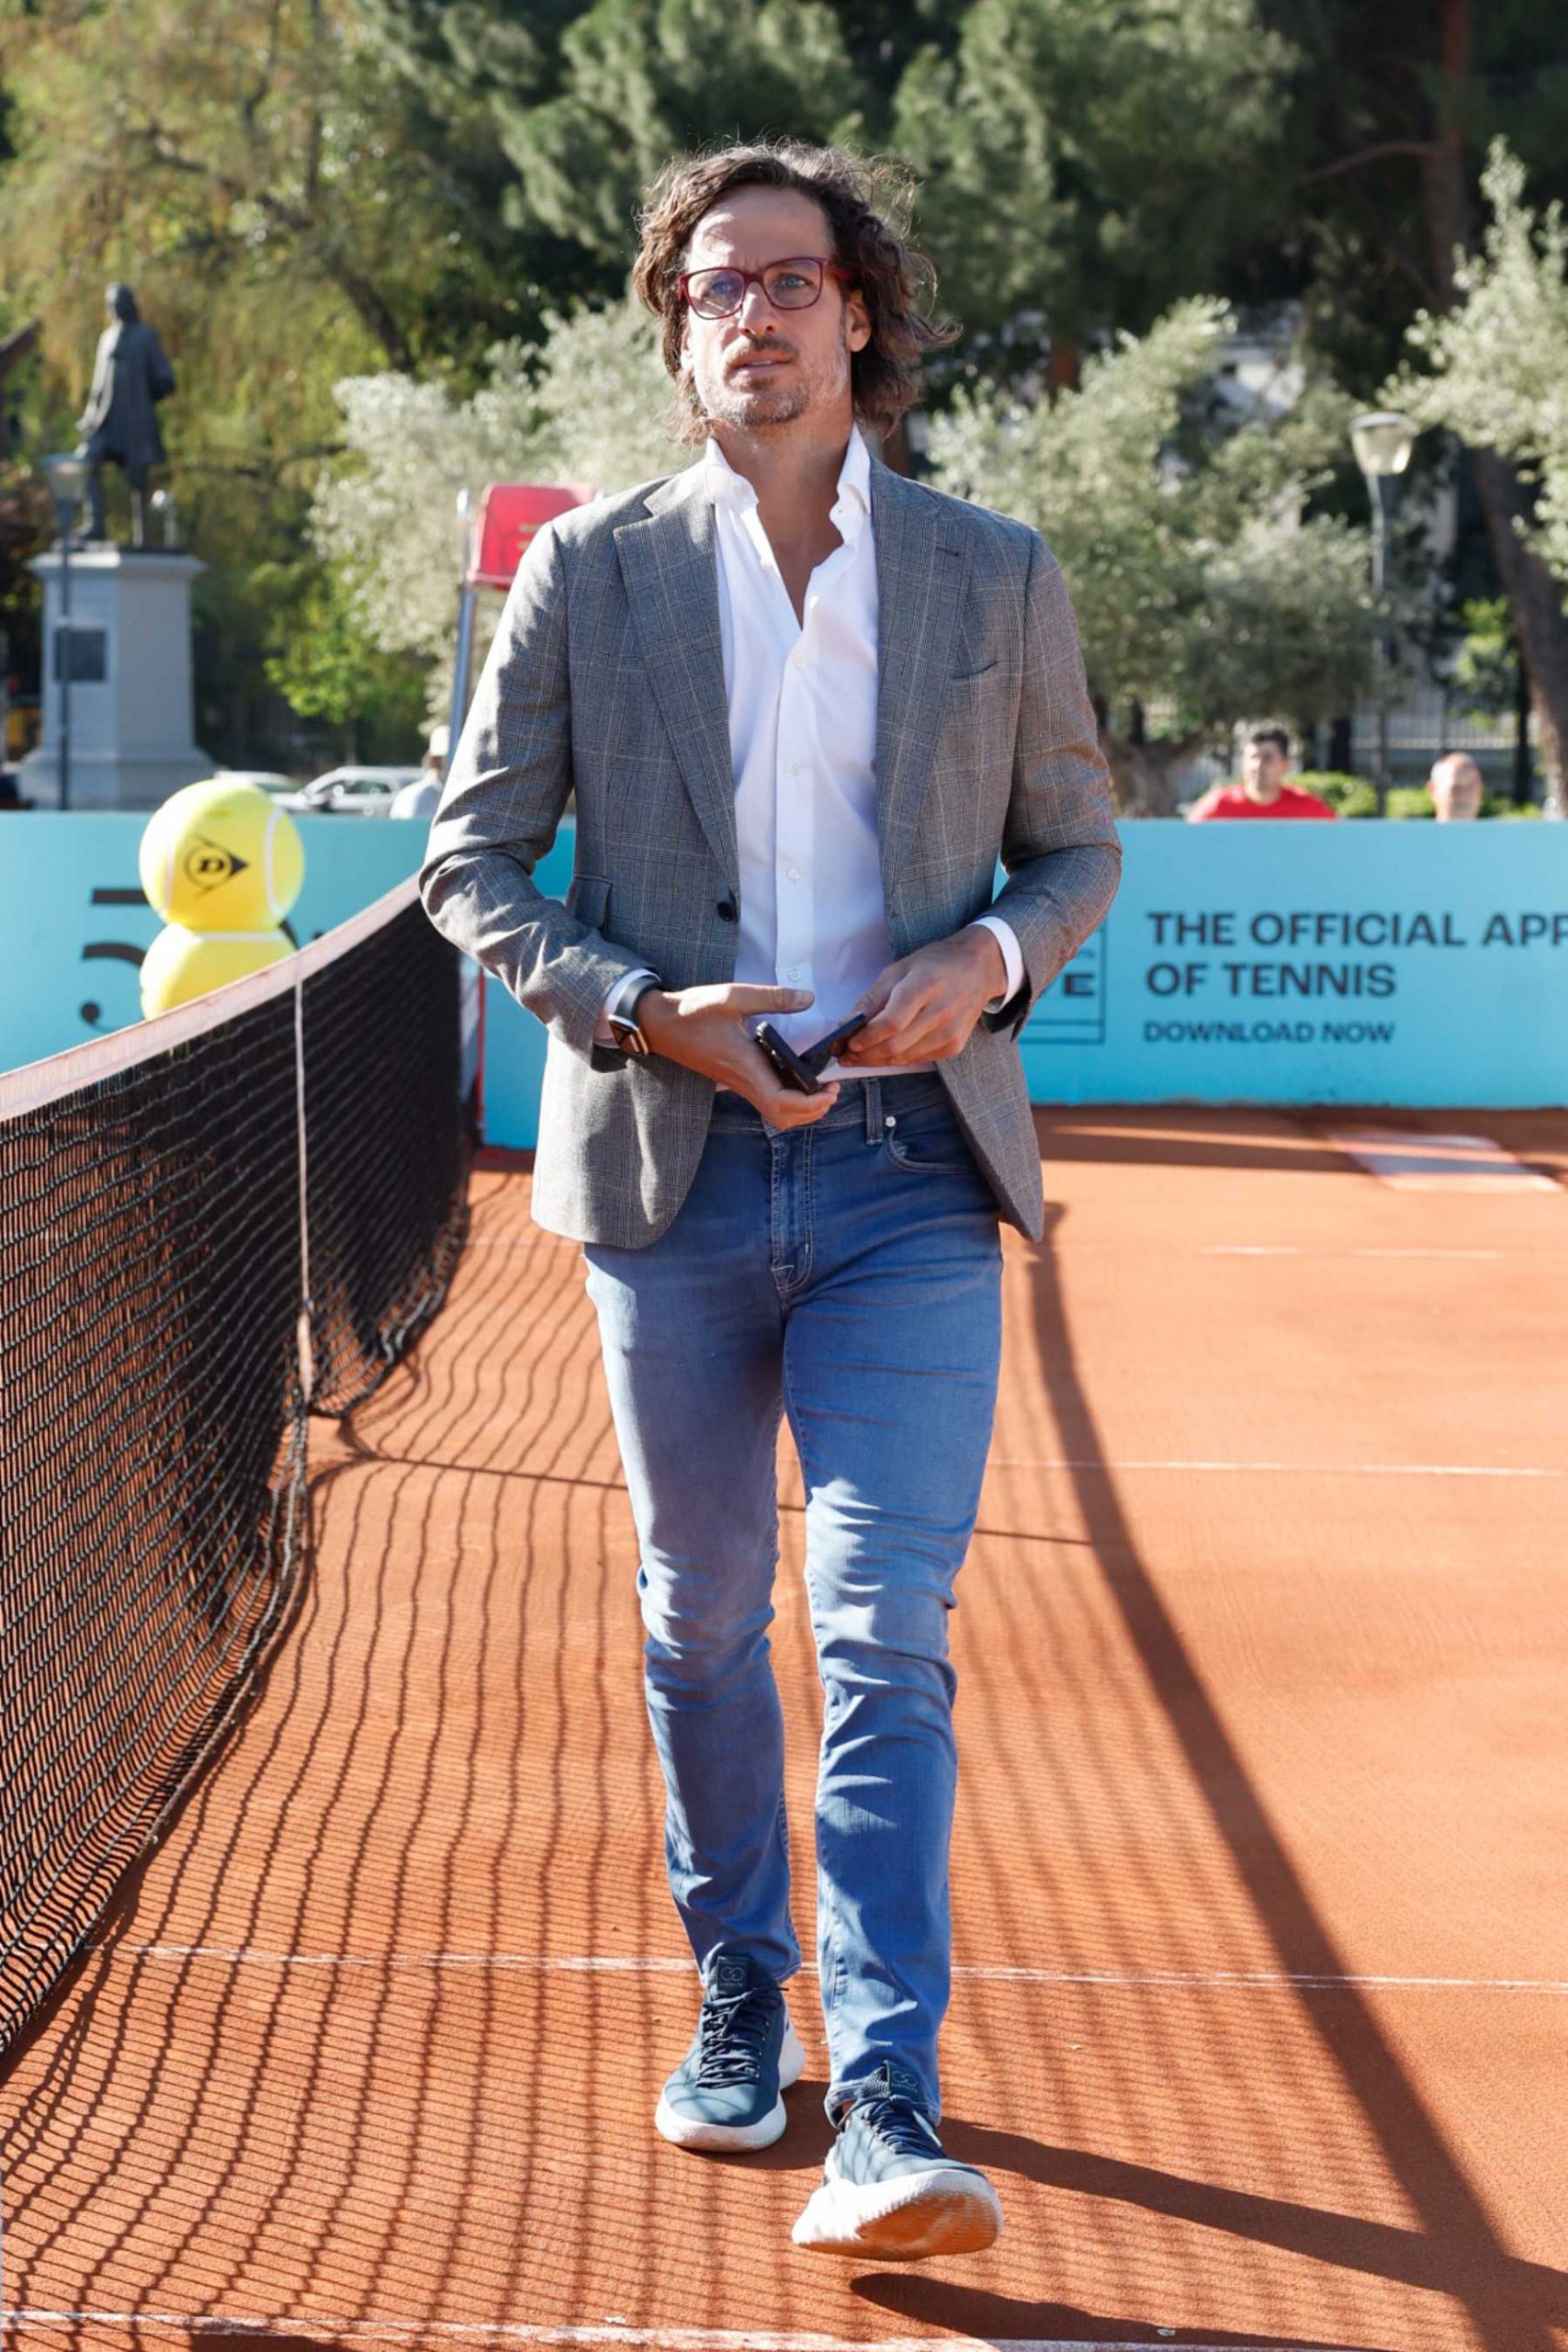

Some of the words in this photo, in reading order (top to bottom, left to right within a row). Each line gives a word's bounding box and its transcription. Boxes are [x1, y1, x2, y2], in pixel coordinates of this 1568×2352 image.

[1146, 911, 1236, 947] THE
[1249, 911, 1467, 948] OFFICIAL
[1145, 962, 1209, 999] OF
[1222, 962, 1397, 999] TENNIS
[1144, 1022, 1314, 1044] DOWNLOAD
[1321, 1022, 1395, 1044] NOW
